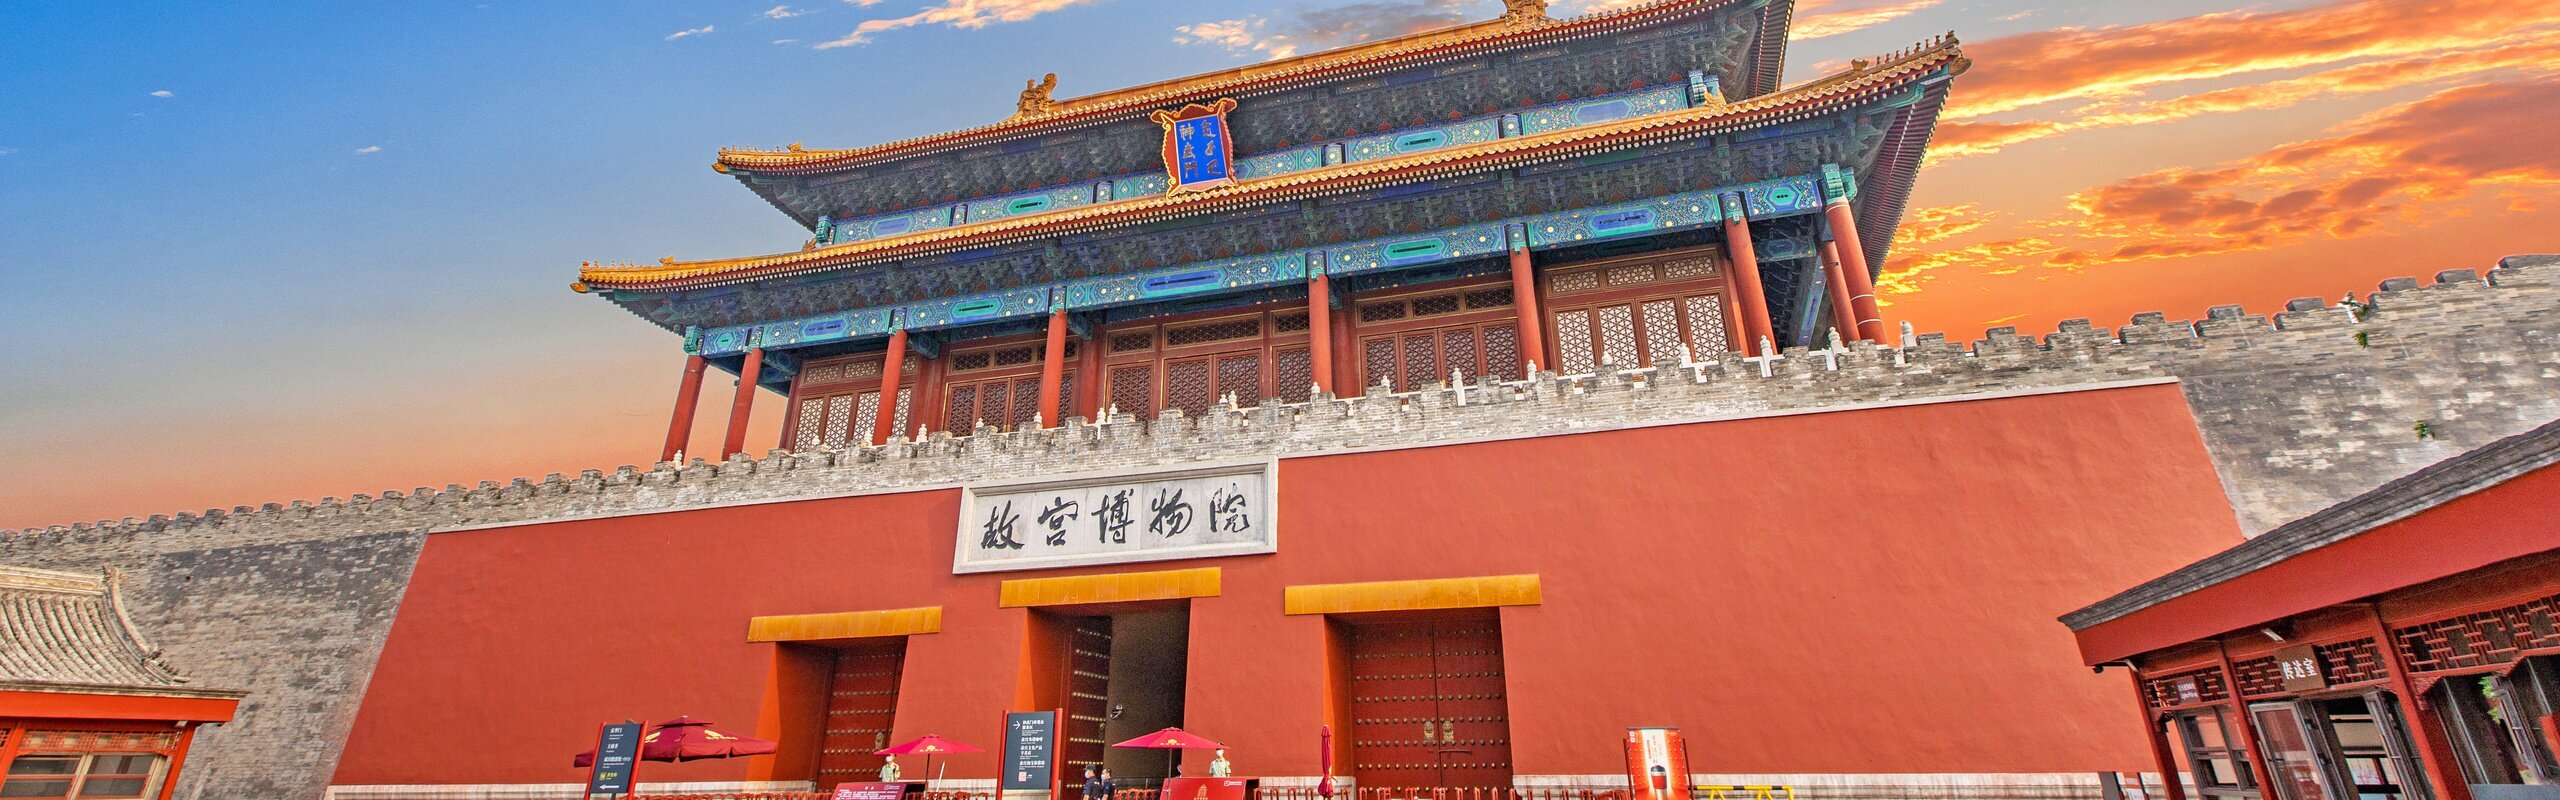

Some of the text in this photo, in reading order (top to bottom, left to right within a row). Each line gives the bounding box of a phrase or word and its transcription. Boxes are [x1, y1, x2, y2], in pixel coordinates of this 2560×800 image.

[981, 483, 1250, 550] 故宫博物院
[2282, 658, 2317, 679] 传达室
